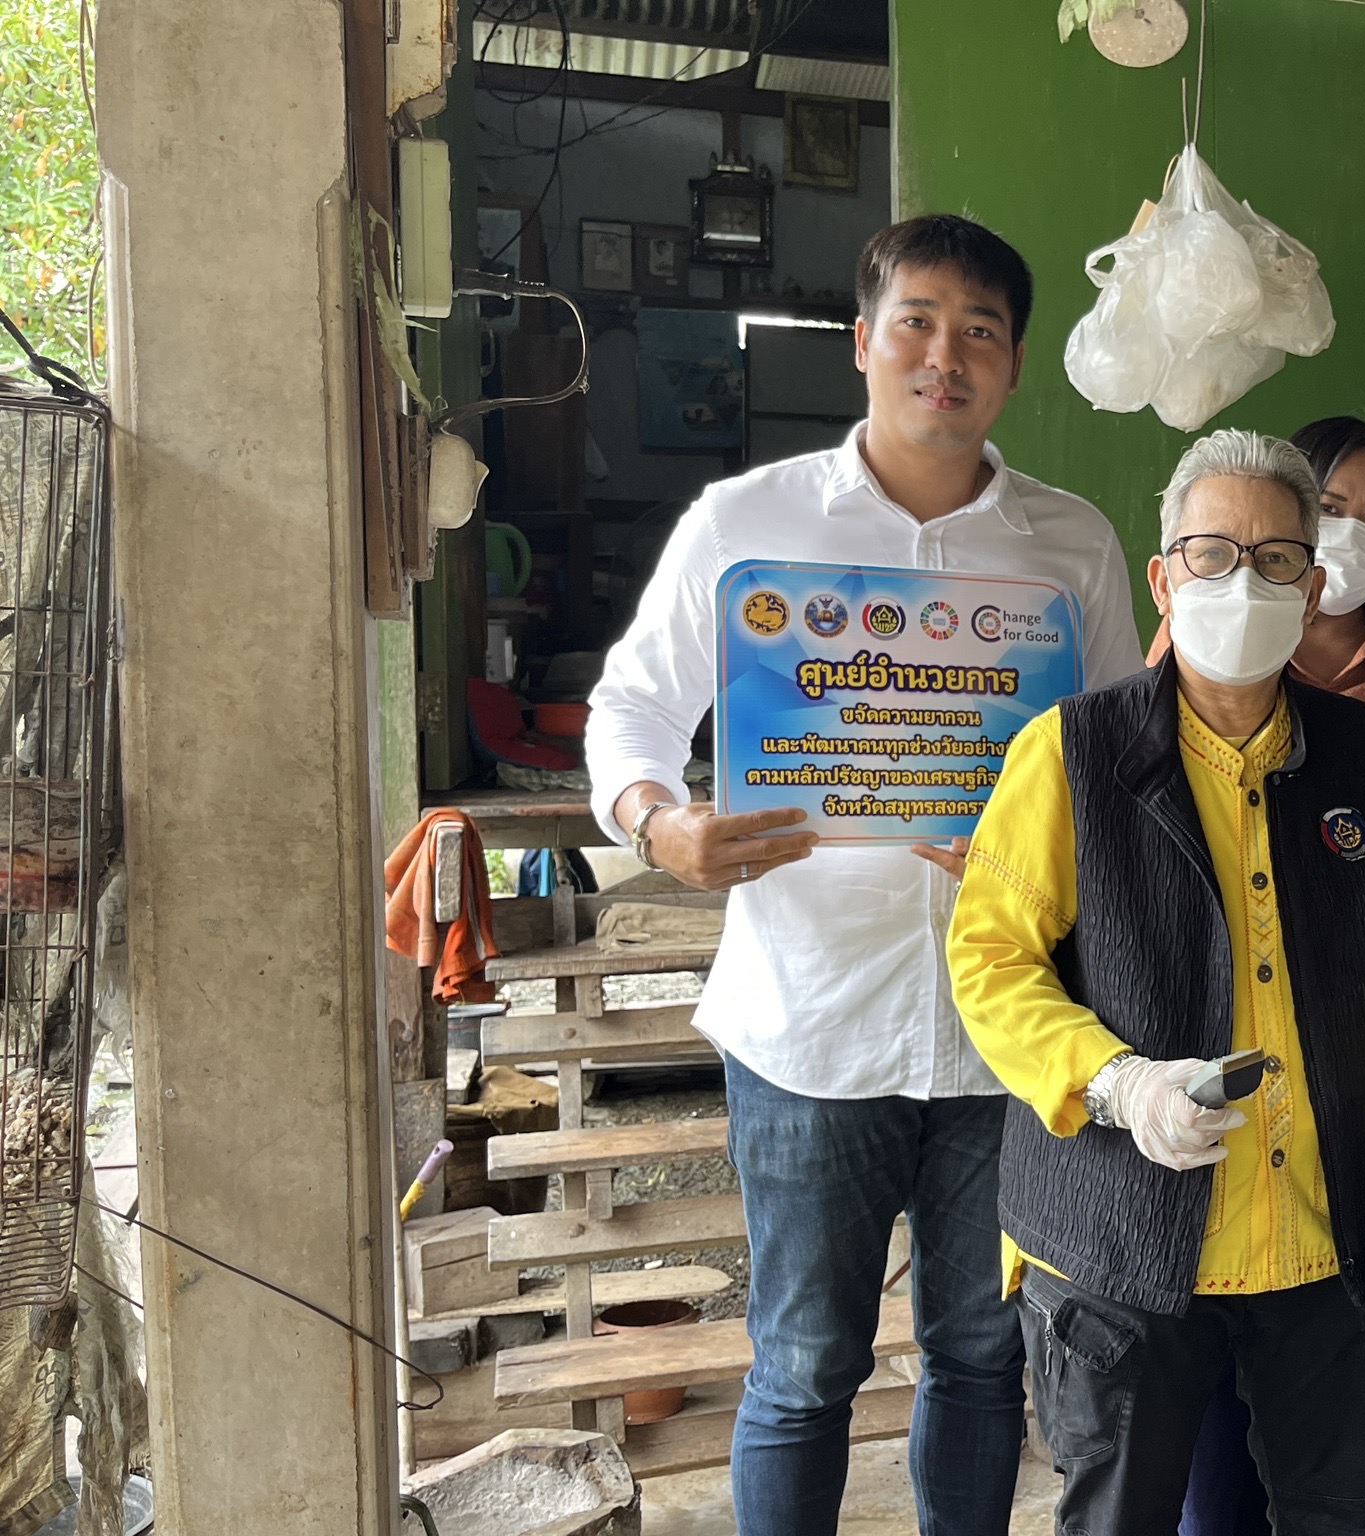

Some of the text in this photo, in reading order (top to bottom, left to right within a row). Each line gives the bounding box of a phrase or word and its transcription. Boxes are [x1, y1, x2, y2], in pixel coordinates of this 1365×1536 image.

[1003, 629, 1059, 643] for Good
[798, 652, 1018, 698] ศูนย์อำนวยการ
[841, 703, 982, 728] ขจัดความยากจน
[762, 733, 1015, 761] และพัฒนาคนทุกช่วงวัยอย่าง
[746, 764, 1002, 790] ตามหลักปรัชญาของเศรษฐกิจ
[824, 795, 988, 821] จังหวัดสมุทรสงครา
